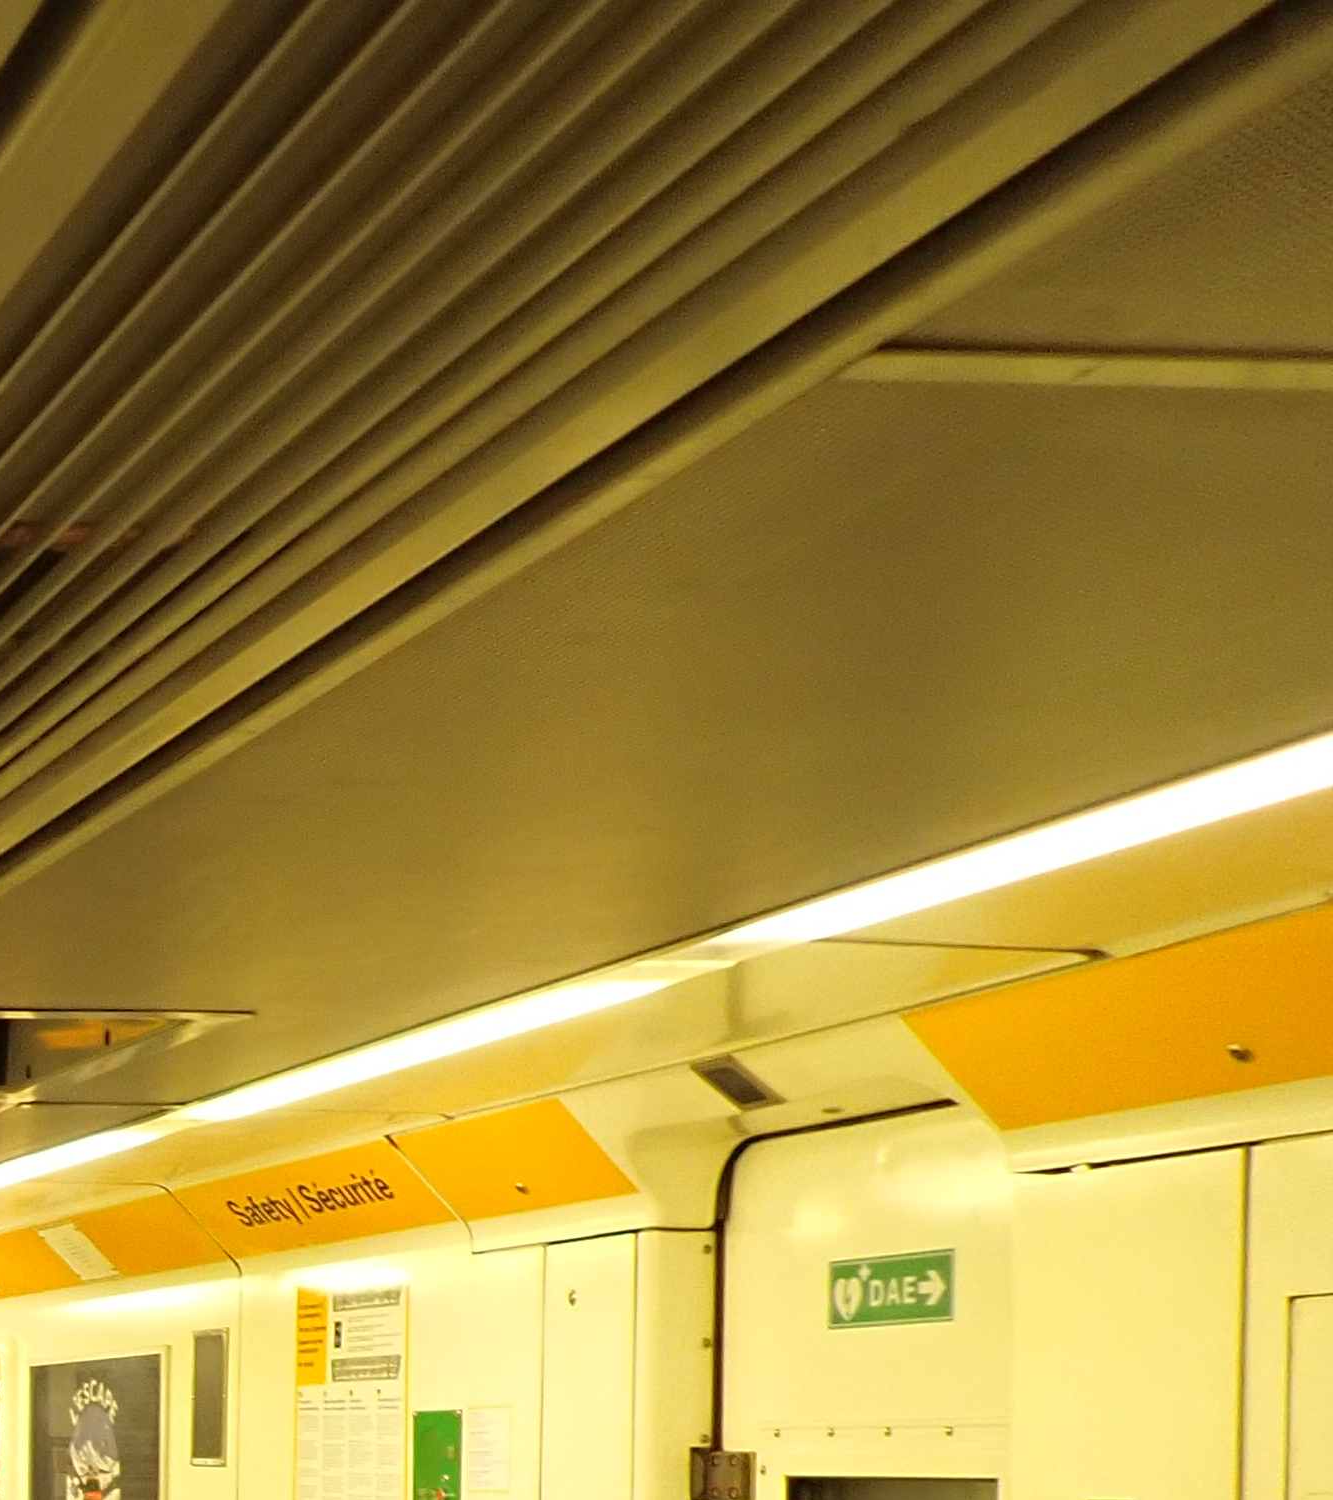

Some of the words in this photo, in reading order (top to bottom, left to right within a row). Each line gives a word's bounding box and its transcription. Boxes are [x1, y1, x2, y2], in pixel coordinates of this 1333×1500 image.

[226, 1195, 303, 1226] Safety
[298, 1169, 396, 1214] Sécurité
[868, 1275, 918, 1307] DAE
